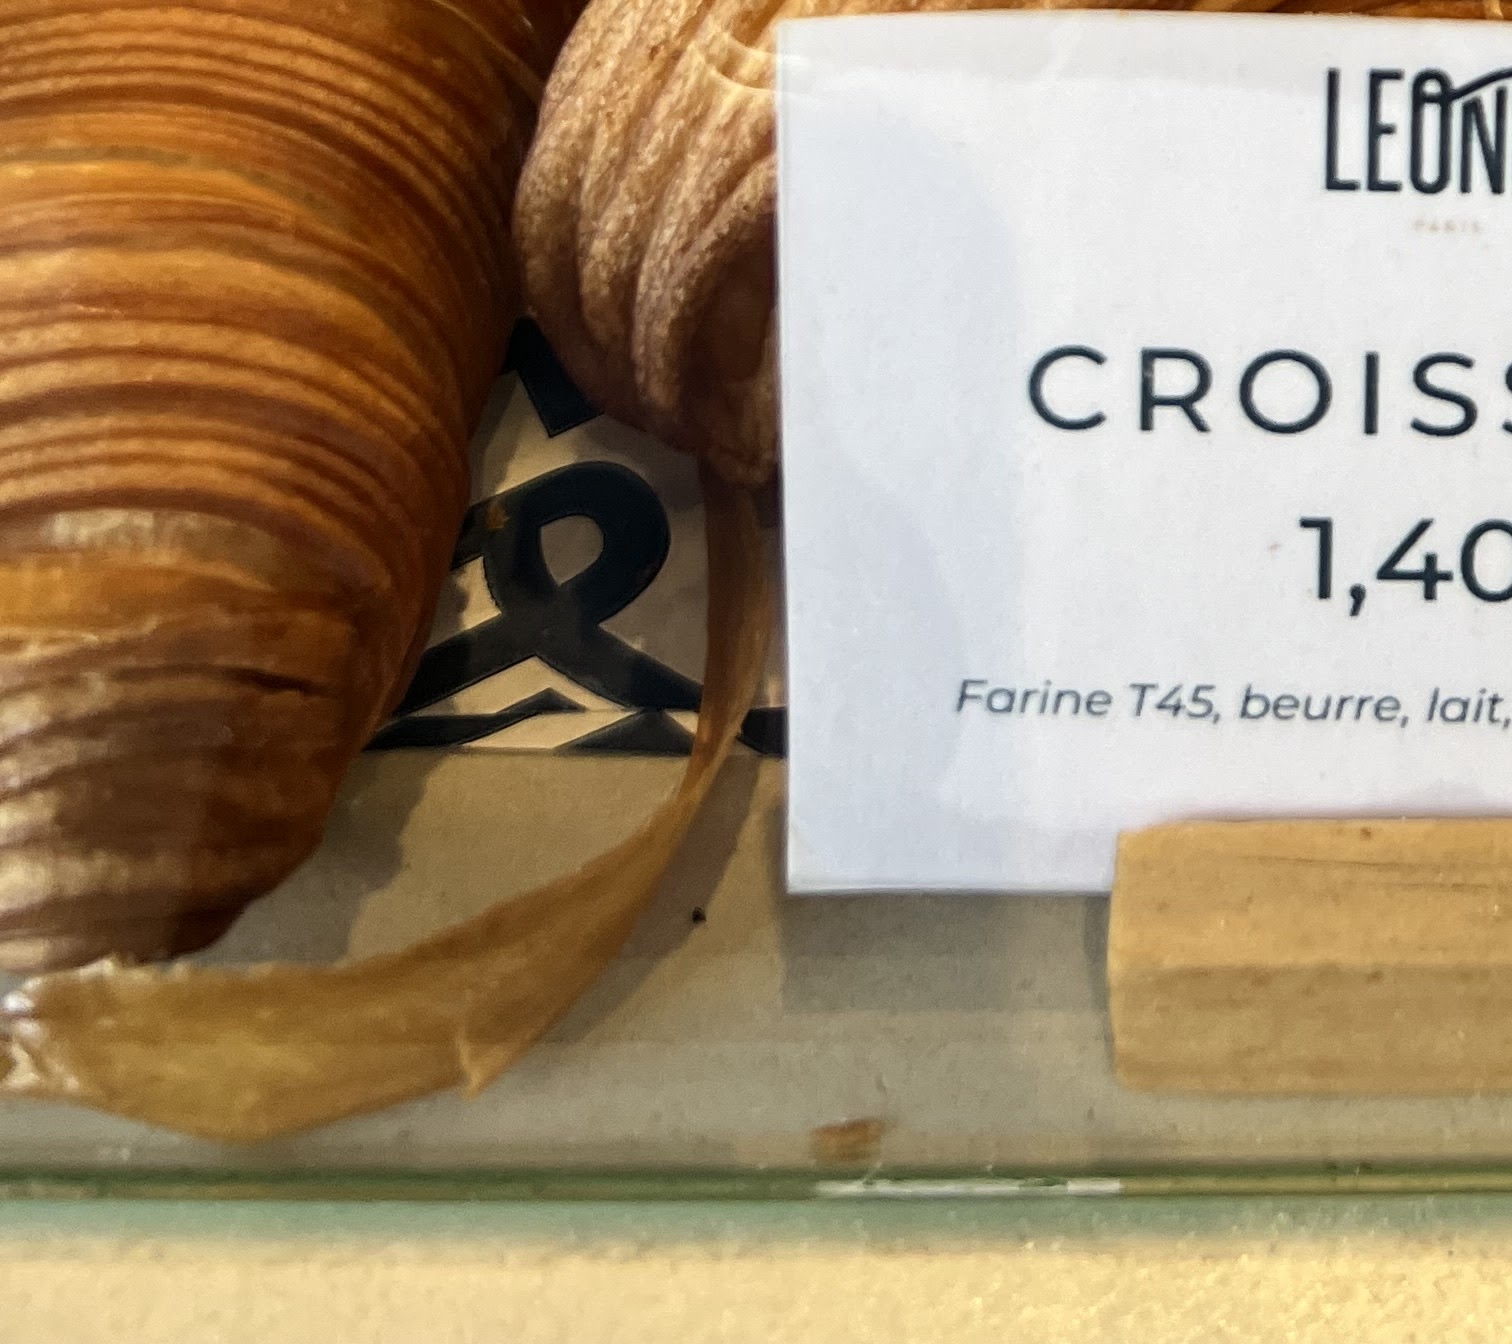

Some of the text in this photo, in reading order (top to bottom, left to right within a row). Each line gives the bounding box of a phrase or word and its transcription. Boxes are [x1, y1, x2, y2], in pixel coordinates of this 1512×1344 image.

[954, 677, 1115, 718] Farine
[1128, 682, 1222, 725] T45,
[1237, 683, 1411, 729] beurre,
[1425, 686, 1512, 730] lait,
